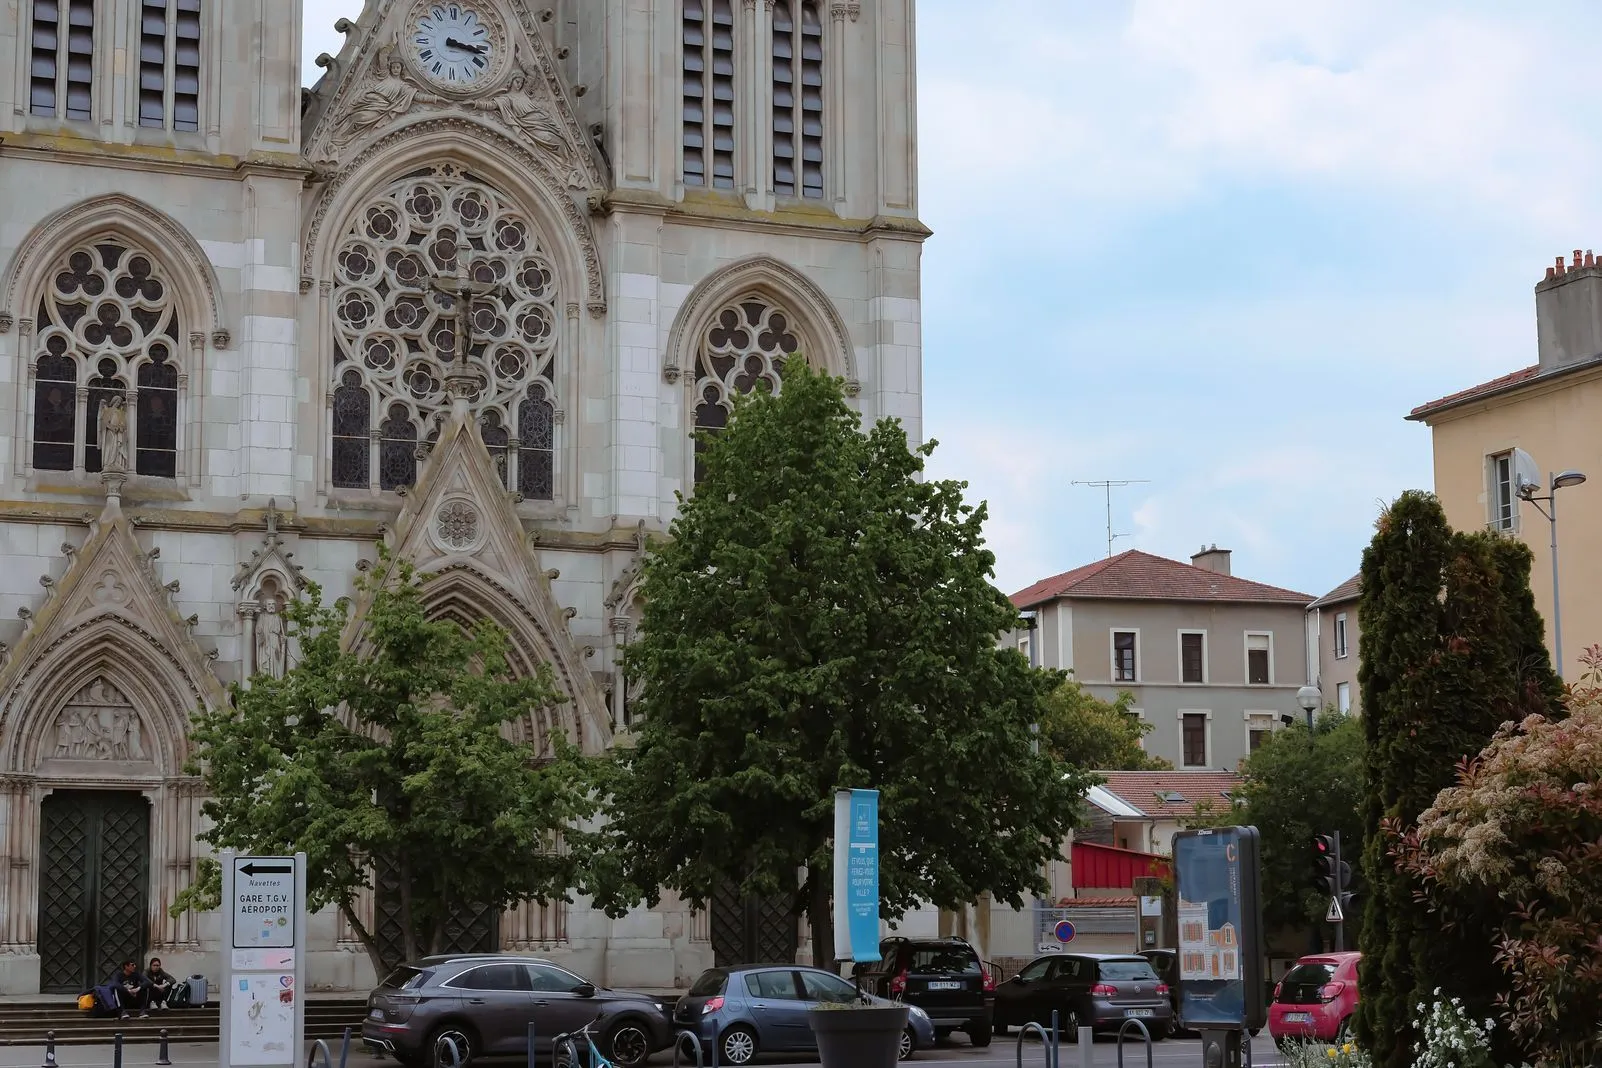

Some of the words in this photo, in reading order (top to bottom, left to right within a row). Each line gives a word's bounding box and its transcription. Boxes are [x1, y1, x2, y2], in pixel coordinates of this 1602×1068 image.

[249, 879, 281, 887] Navettes
[240, 894, 263, 903] GARE
[266, 894, 289, 903] T.G.V.
[241, 903, 288, 914] AÉROPORT
